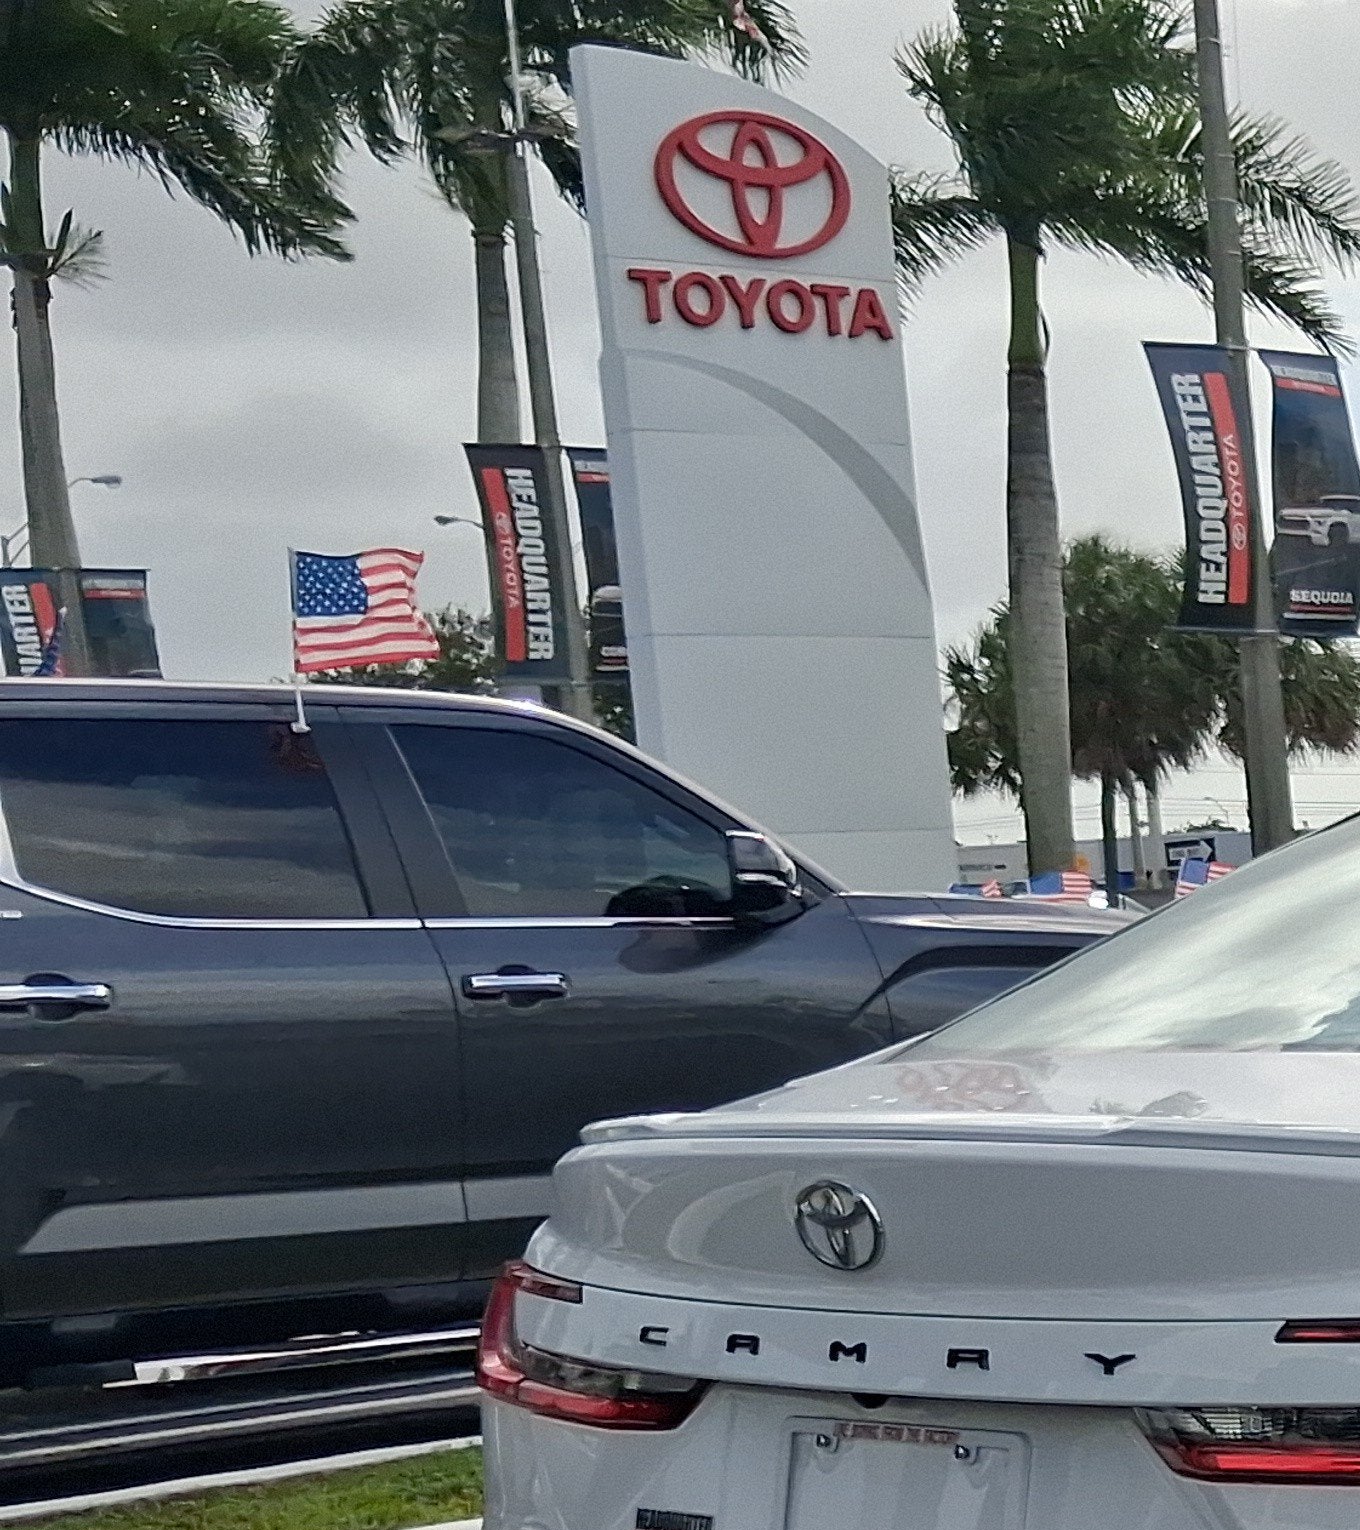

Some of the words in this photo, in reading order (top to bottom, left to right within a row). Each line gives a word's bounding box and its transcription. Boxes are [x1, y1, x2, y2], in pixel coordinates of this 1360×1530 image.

[627, 268, 893, 341] TOYOTA
[1171, 373, 1228, 604] HEADQUARTER
[1223, 434, 1246, 518] TOYOTA
[500, 538, 520, 608] TOYOTA
[504, 468, 554, 660] HEADQUARTER
[1290, 588, 1353, 605] SEQUOIA
[639, 1326, 1137, 1375] CAMRY
